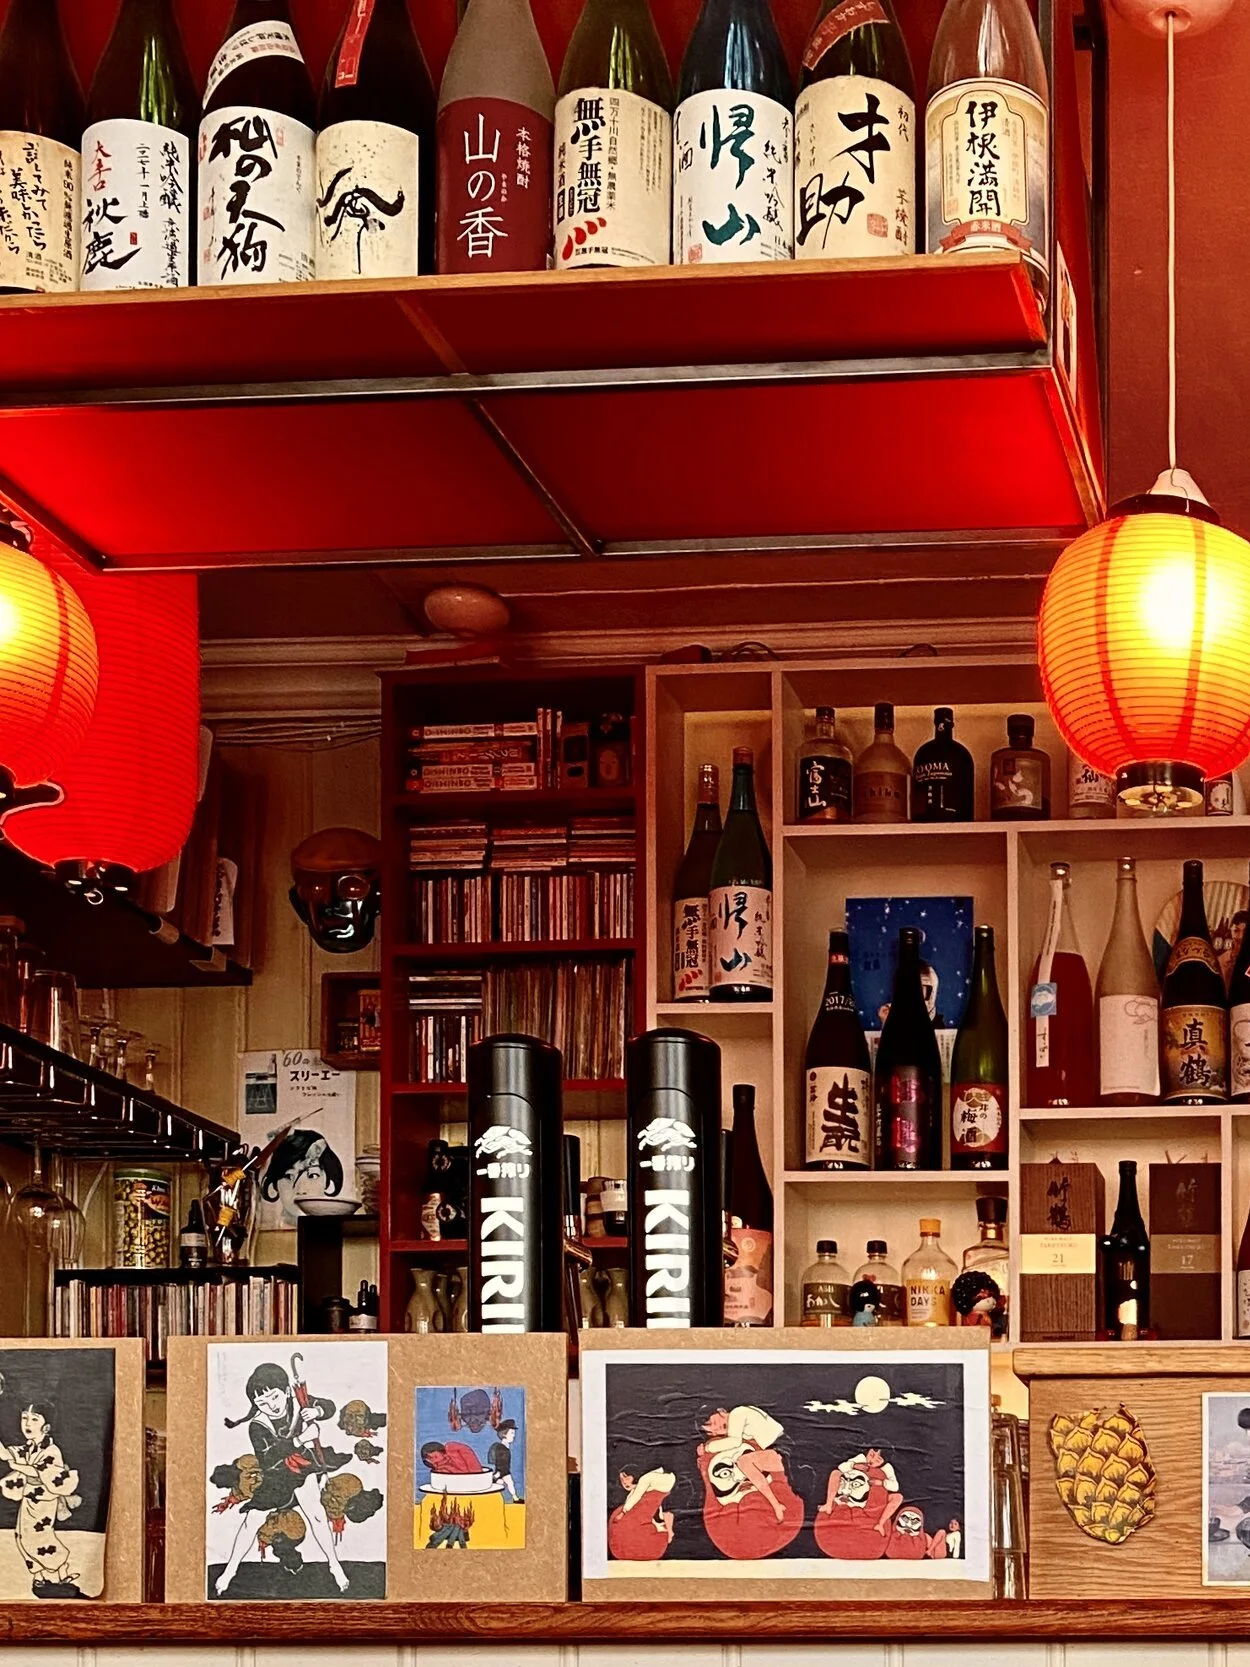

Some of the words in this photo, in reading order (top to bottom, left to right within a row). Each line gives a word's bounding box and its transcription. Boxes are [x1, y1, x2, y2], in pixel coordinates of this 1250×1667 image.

[897, 104, 909, 142] 初代
[87, 140, 113, 192] 大辛口
[456, 112, 509, 259] 山の香
[514, 126, 532, 190] 本格焼酎
[570, 96, 607, 214] 無手無冠
[699, 103, 761, 247] 帰山
[795, 92, 891, 250] 才助
[965, 100, 1001, 217] 伊根満開
[9, 167, 47, 251] 美味しかったら
[82, 197, 142, 276] 秋鹿
[895, 187, 909, 247] 芋焼酎
[681, 904, 701, 968] 無手無冠
[289, 1070, 341, 1082] スリーエー
[1178, 1017, 1212, 1087] 真鶴
[960, 1108, 978, 1146] 梅酒
[1046, 1176, 1072, 1231] 竹鶴
[1052, 1253, 1065, 1264] 21
[1181, 1254, 1195, 1266] 17
[909, 1285, 946, 1296] NIKKA
[909, 1296, 938, 1307] DAYS
